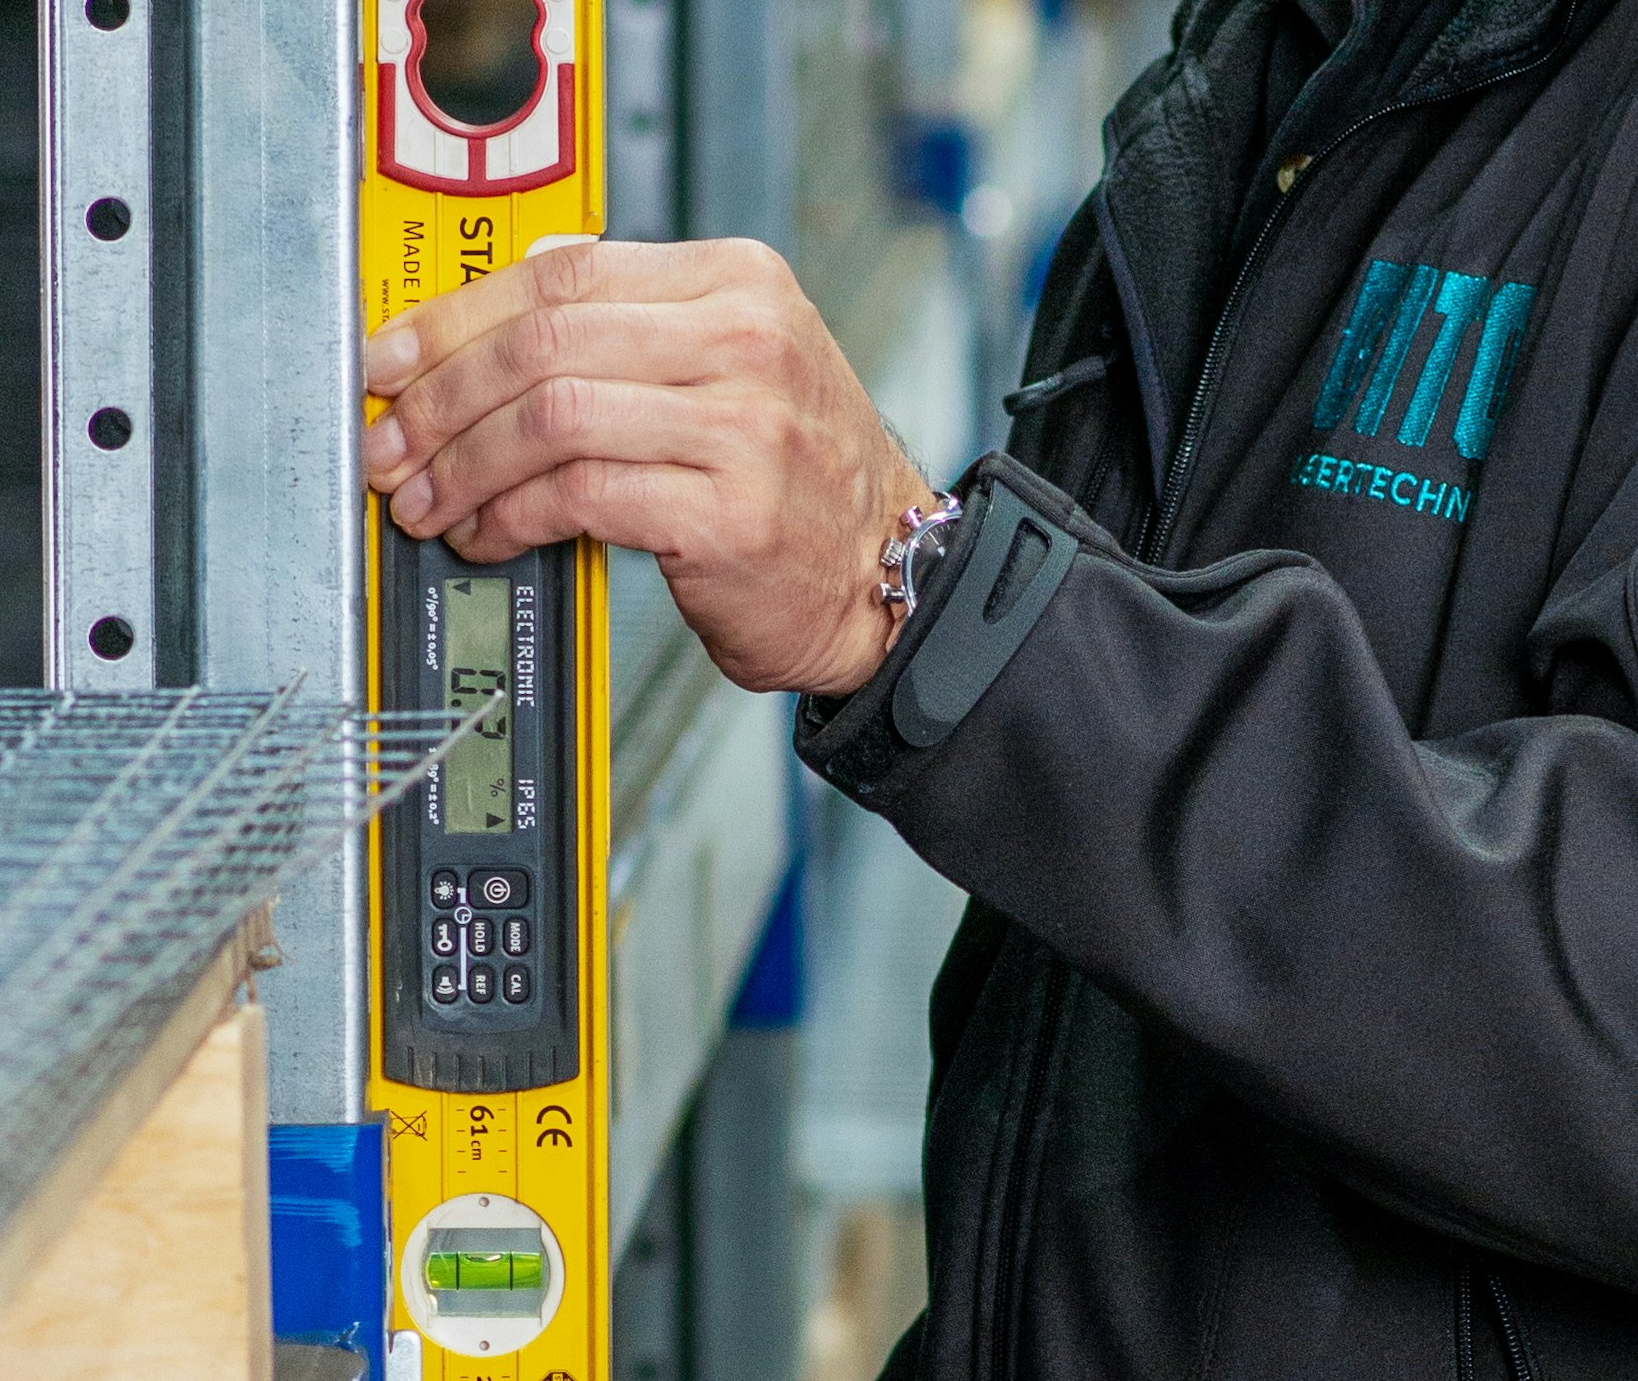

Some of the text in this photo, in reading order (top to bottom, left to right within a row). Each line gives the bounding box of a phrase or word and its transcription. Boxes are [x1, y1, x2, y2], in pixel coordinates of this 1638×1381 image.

[459, 216, 494, 286] STA
[516, 585, 535, 708] ELECTRONIC
[517, 778, 536, 830] IP65
[475, 922, 486, 953] HOLD
[510, 922, 521, 952] MODE
[475, 974, 486, 995] REF
[511, 973, 522, 995] CAL
[469, 1105, 495, 1161] 61 cm
[536, 1104, 573, 1148] CE
